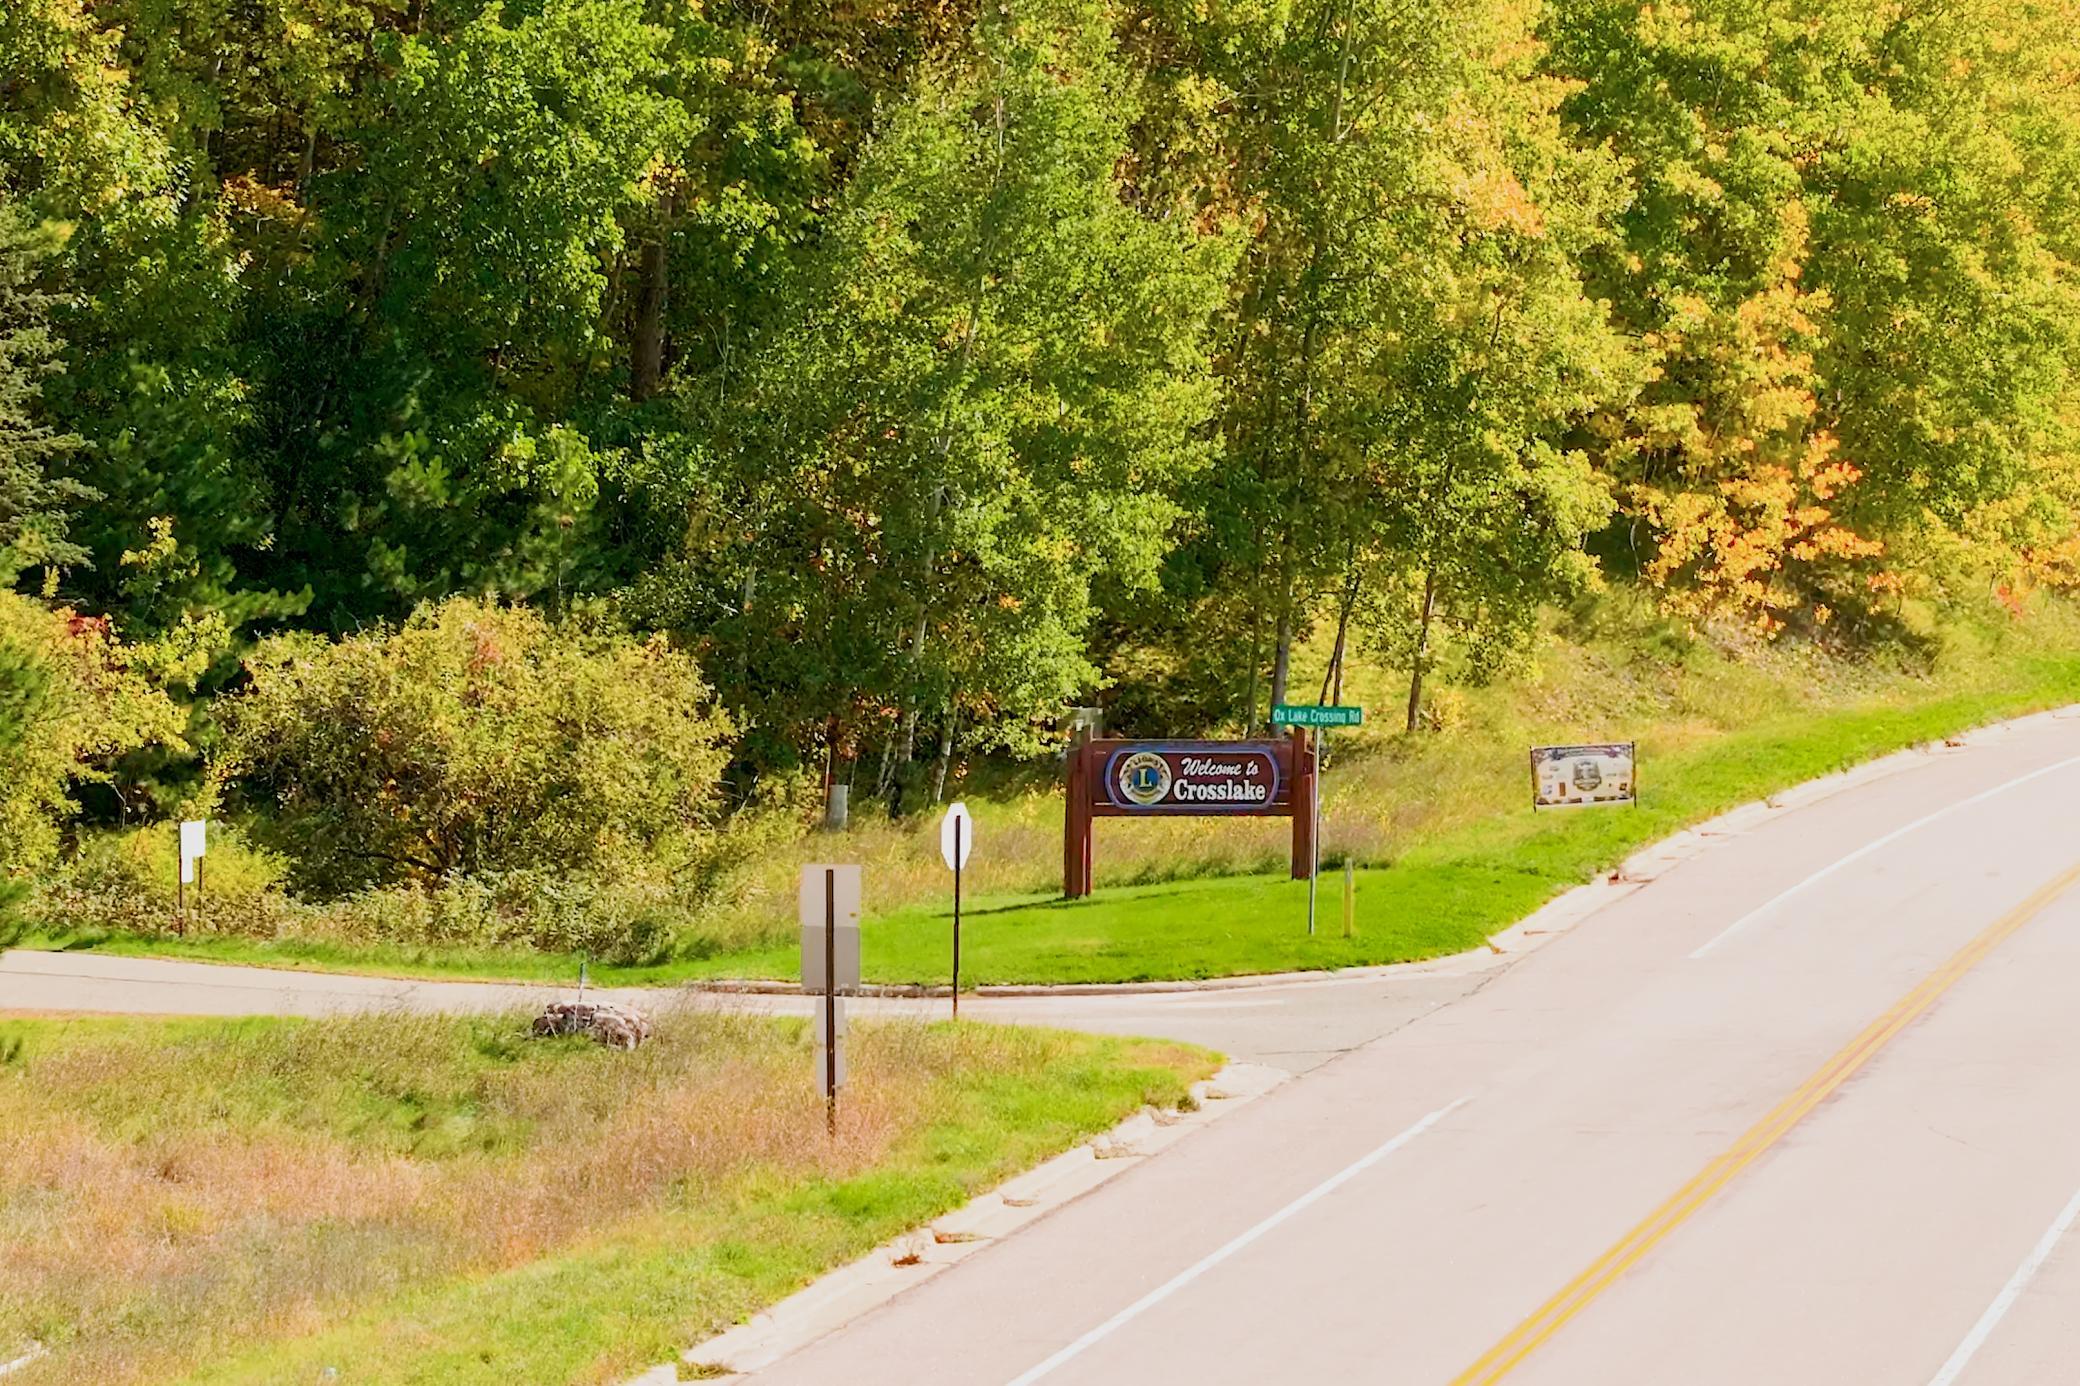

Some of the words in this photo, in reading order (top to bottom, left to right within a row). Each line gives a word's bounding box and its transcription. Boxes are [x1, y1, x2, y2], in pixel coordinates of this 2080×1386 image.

[1274, 709, 1285, 722] Ox
[1288, 709, 1308, 723] Lake
[1311, 709, 1346, 724] Crossing
[1349, 710, 1360, 723] Rd
[1181, 757, 1242, 777] Welcome
[1246, 760, 1259, 776] to
[1139, 768, 1152, 788] L
[1173, 779, 1266, 801] Crosslake
